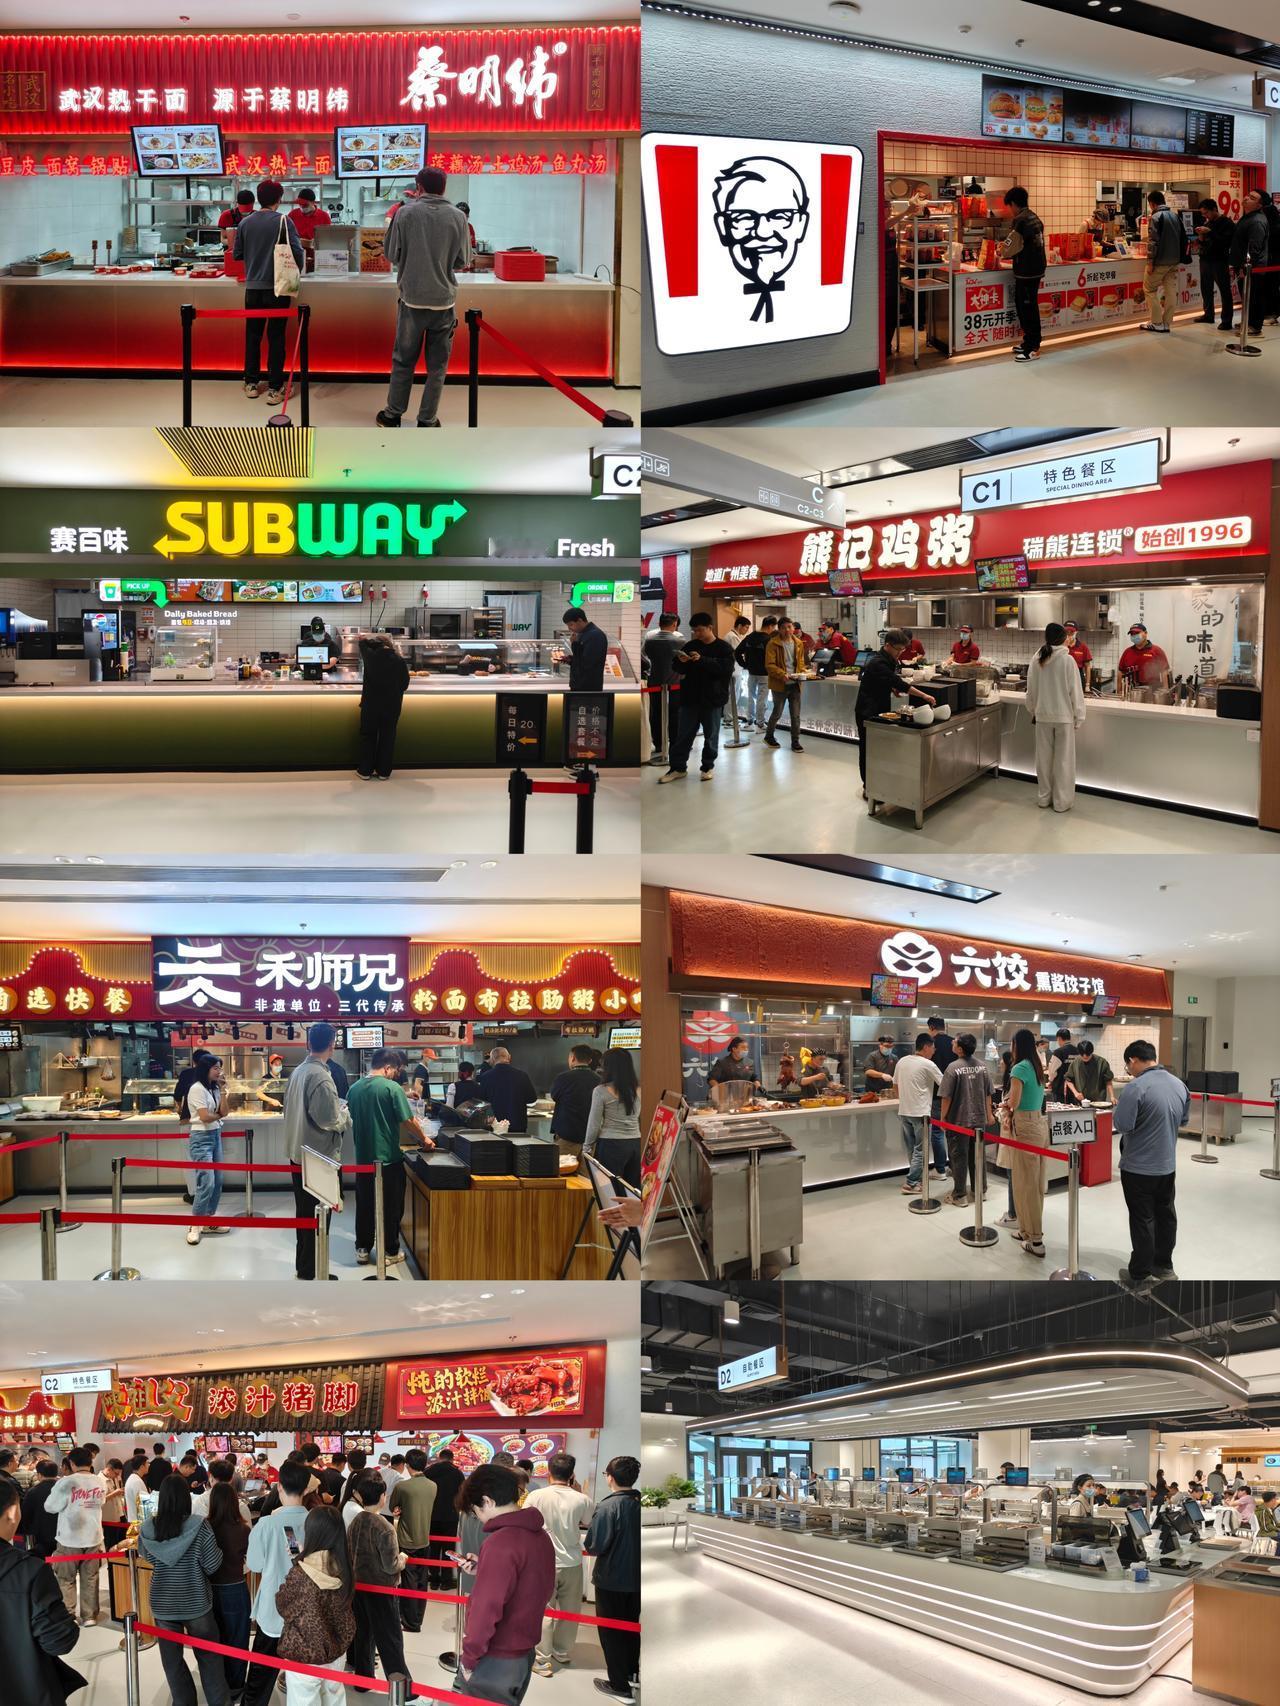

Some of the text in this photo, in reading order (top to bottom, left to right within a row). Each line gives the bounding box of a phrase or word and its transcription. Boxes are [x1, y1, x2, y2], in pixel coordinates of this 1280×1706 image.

[400, 45, 557, 119] 蔡明纬
[59, 86, 349, 112] 武汉热干面 源于蔡明纬
[0, 156, 36, 176] 豆皮
[91, 155, 129, 176] 锅贴
[225, 154, 331, 176] 武汉热干面
[489, 154, 542, 174] 土鸡汤
[551, 154, 607, 174] 鱼丸汤
[970, 292, 999, 307] 大神卡
[1043, 459, 1116, 484] 特色餐区
[812, 487, 824, 503] C
[973, 479, 1001, 504] C1
[1046, 478, 1112, 493] SPECIAL DINING AREA
[797, 503, 824, 519] C2-C3
[153, 498, 467, 559] SUBWAY
[1142, 522, 1243, 549] 始创1996
[50, 527, 129, 554] 赛百味
[557, 538, 615, 557] Fresh
[799, 512, 974, 575] 熊记鸡粥
[1023, 528, 1123, 560] 瑞熊连锁
[704, 565, 759, 582] 地道广州美食
[164, 611, 186, 619] Daily
[507, 706, 518, 752] 每日特价
[520, 720, 534, 729] 20
[577, 706, 586, 747] 自选套餐
[255, 951, 405, 992] 禾师兄
[950, 946, 1031, 991] 六饺
[1035, 970, 1105, 996] 熏酱饺子馆
[255, 999, 405, 1013] 非遗单位·三代传承
[1053, 1120, 1093, 1136] 点餐入口
[44, 1378, 59, 1391] C2
[407, 1366, 489, 1395] 炖的软烂
[721, 1369, 731, 1385] D2
[208, 1381, 358, 1415] 浓汁猪脚
[0, 1413, 60, 1429] 拉肠粥小吃
